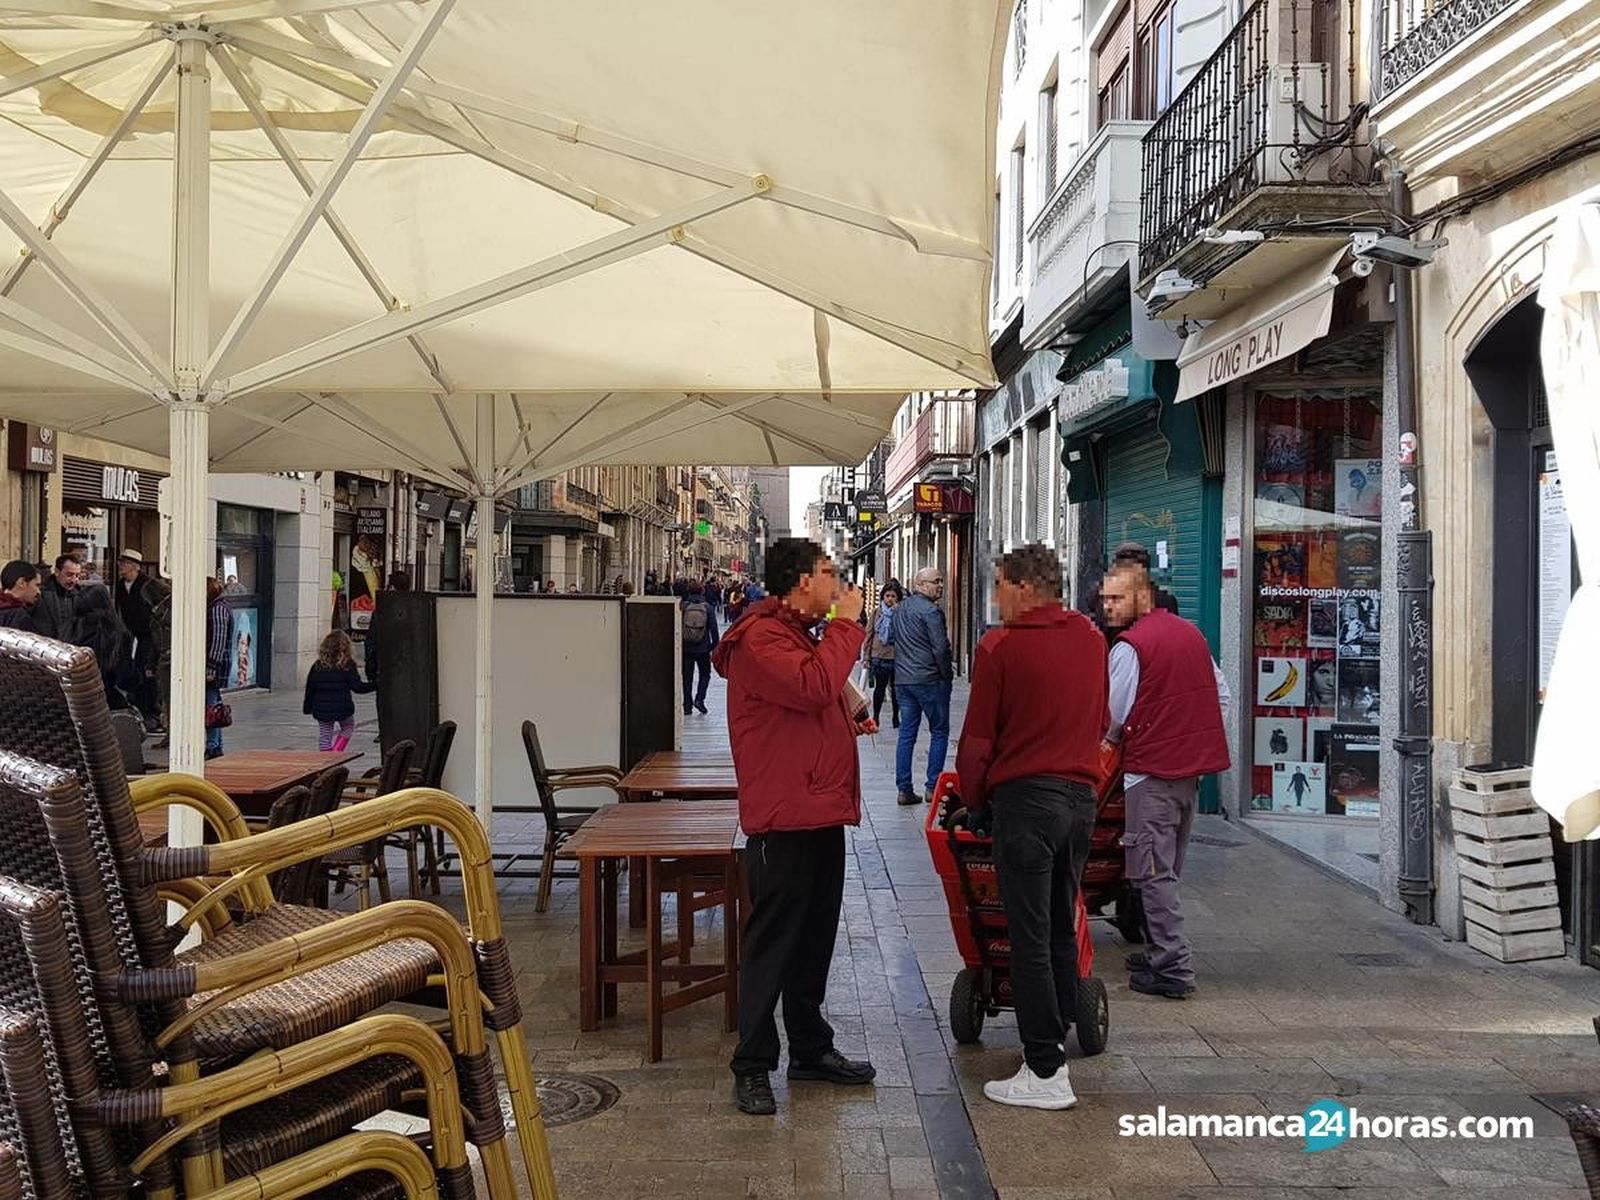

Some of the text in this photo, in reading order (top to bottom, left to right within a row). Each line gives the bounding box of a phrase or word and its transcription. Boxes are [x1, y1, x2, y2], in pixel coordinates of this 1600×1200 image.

[1207, 321, 1284, 385] LONG PLAY
[102, 466, 139, 502] MULAS
[1260, 586, 1379, 599] discoslongplay.com
